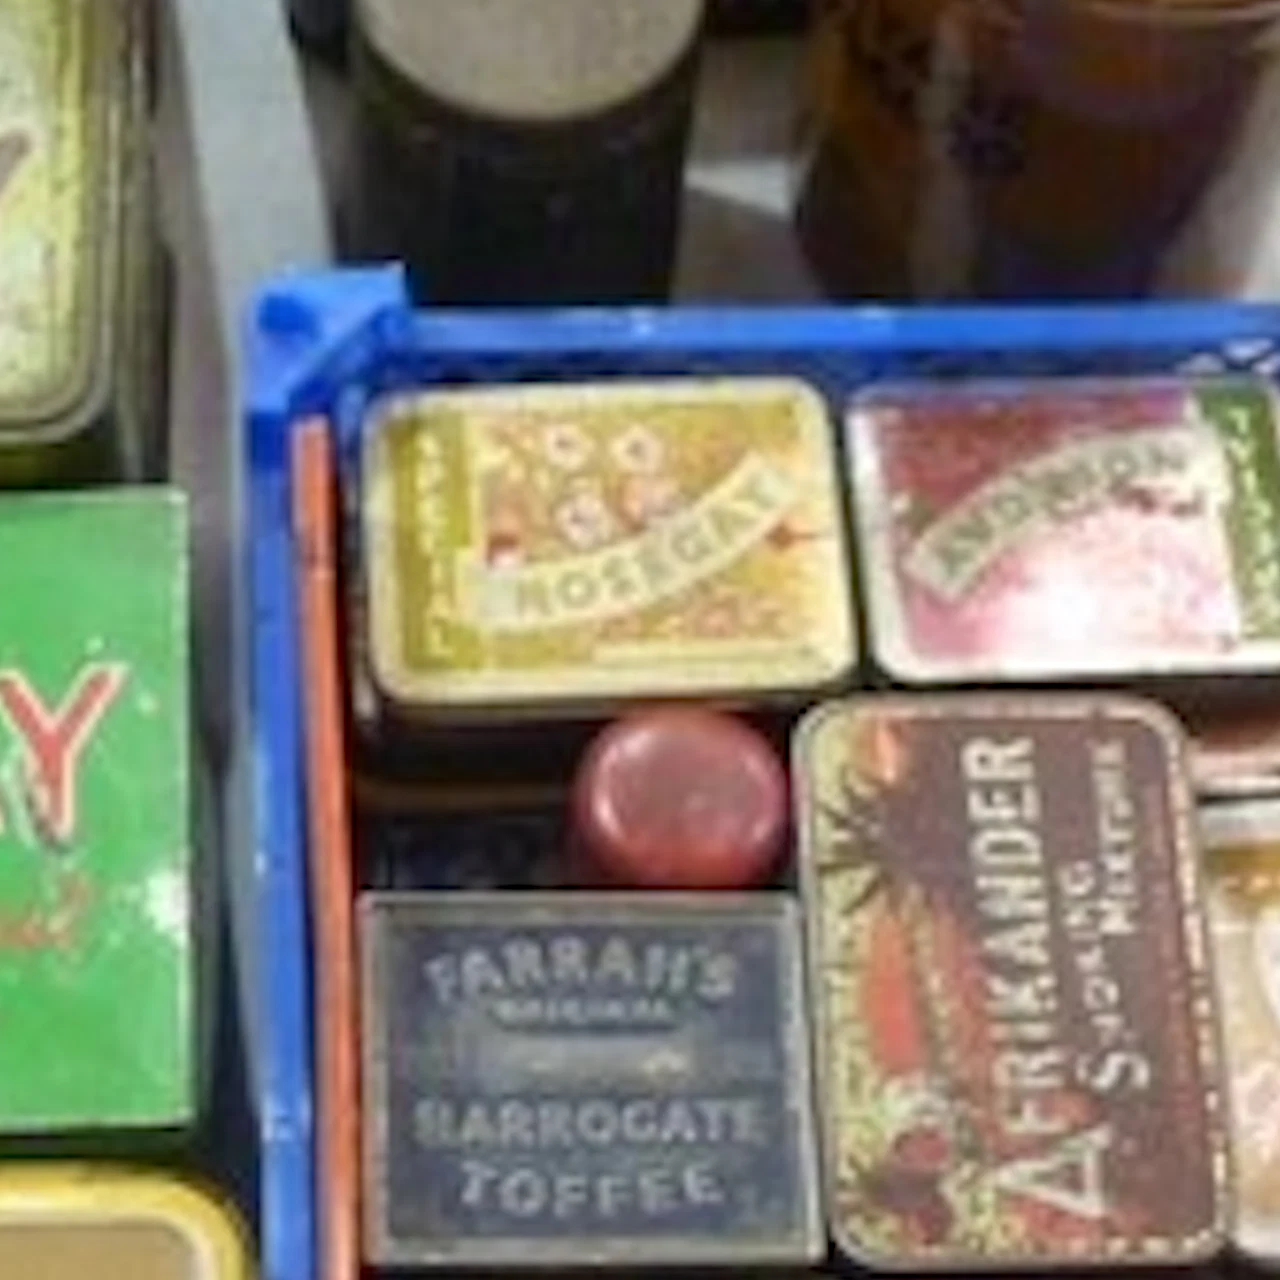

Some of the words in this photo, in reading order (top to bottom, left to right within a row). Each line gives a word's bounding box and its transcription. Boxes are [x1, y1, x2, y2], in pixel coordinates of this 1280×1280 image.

[960, 732, 1114, 1222] AFRIKANDER
[412, 1094, 770, 1152] HARROGATE
[458, 1160, 726, 1220] TOFFEE
